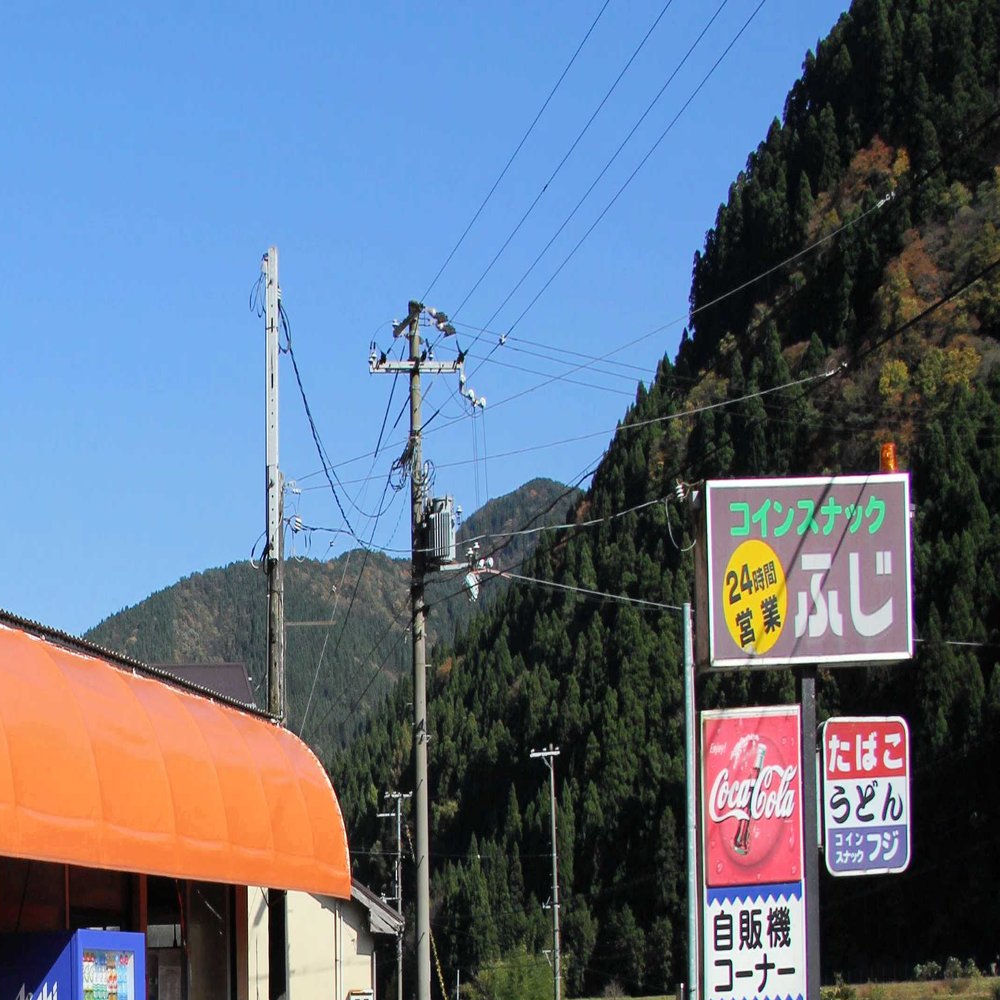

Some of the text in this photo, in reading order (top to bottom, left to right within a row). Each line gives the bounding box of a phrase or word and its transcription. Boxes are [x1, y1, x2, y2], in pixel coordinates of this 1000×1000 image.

[729, 495, 886, 538] コインスナック
[726, 560, 778, 606] 24時間
[794, 551, 894, 638] ふじ
[735, 594, 781, 648] 営業
[828, 732, 903, 772] たばこ
[830, 780, 903, 824] うどん
[835, 832, 863, 846] コイン
[836, 850, 863, 864] スナック
[867, 830, 899, 861] フジ
[714, 906, 791, 951] 自販機
[714, 953, 796, 993] コーナー
